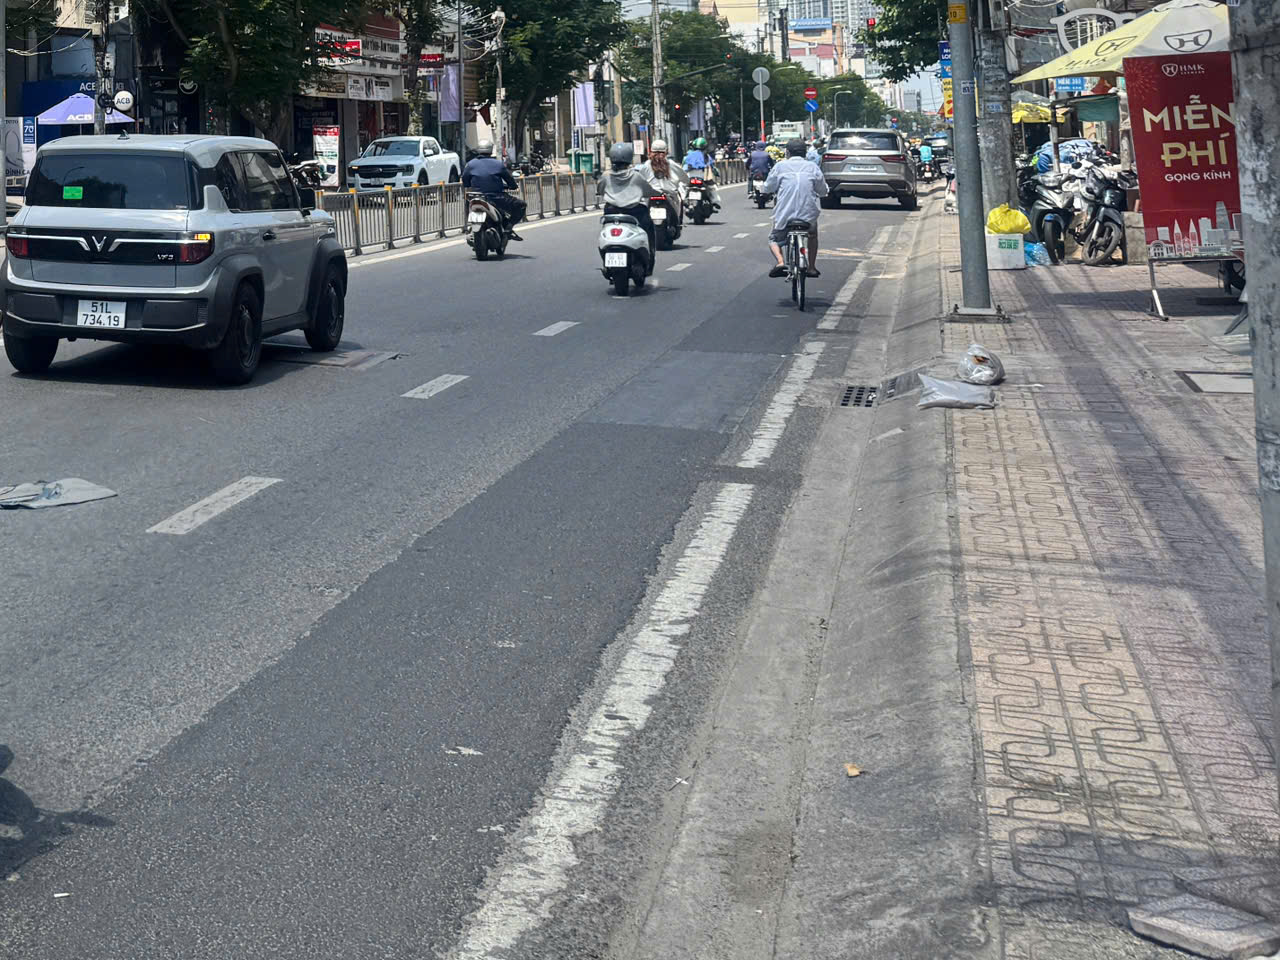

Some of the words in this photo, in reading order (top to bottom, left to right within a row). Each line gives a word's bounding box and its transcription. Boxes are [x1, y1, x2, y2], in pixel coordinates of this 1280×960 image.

[1179, 64, 1205, 72] HMK
[115, 97, 131, 105] ACB
[66, 113, 93, 121] ACB
[1142, 95, 1236, 133] MIỄN
[1161, 132, 1230, 168] PHÍ
[1164, 172, 1201, 183] GỌNG
[1203, 169, 1231, 181] KÍNH
[91, 301, 112, 314] 51L
[82, 313, 120, 327] 734.19
